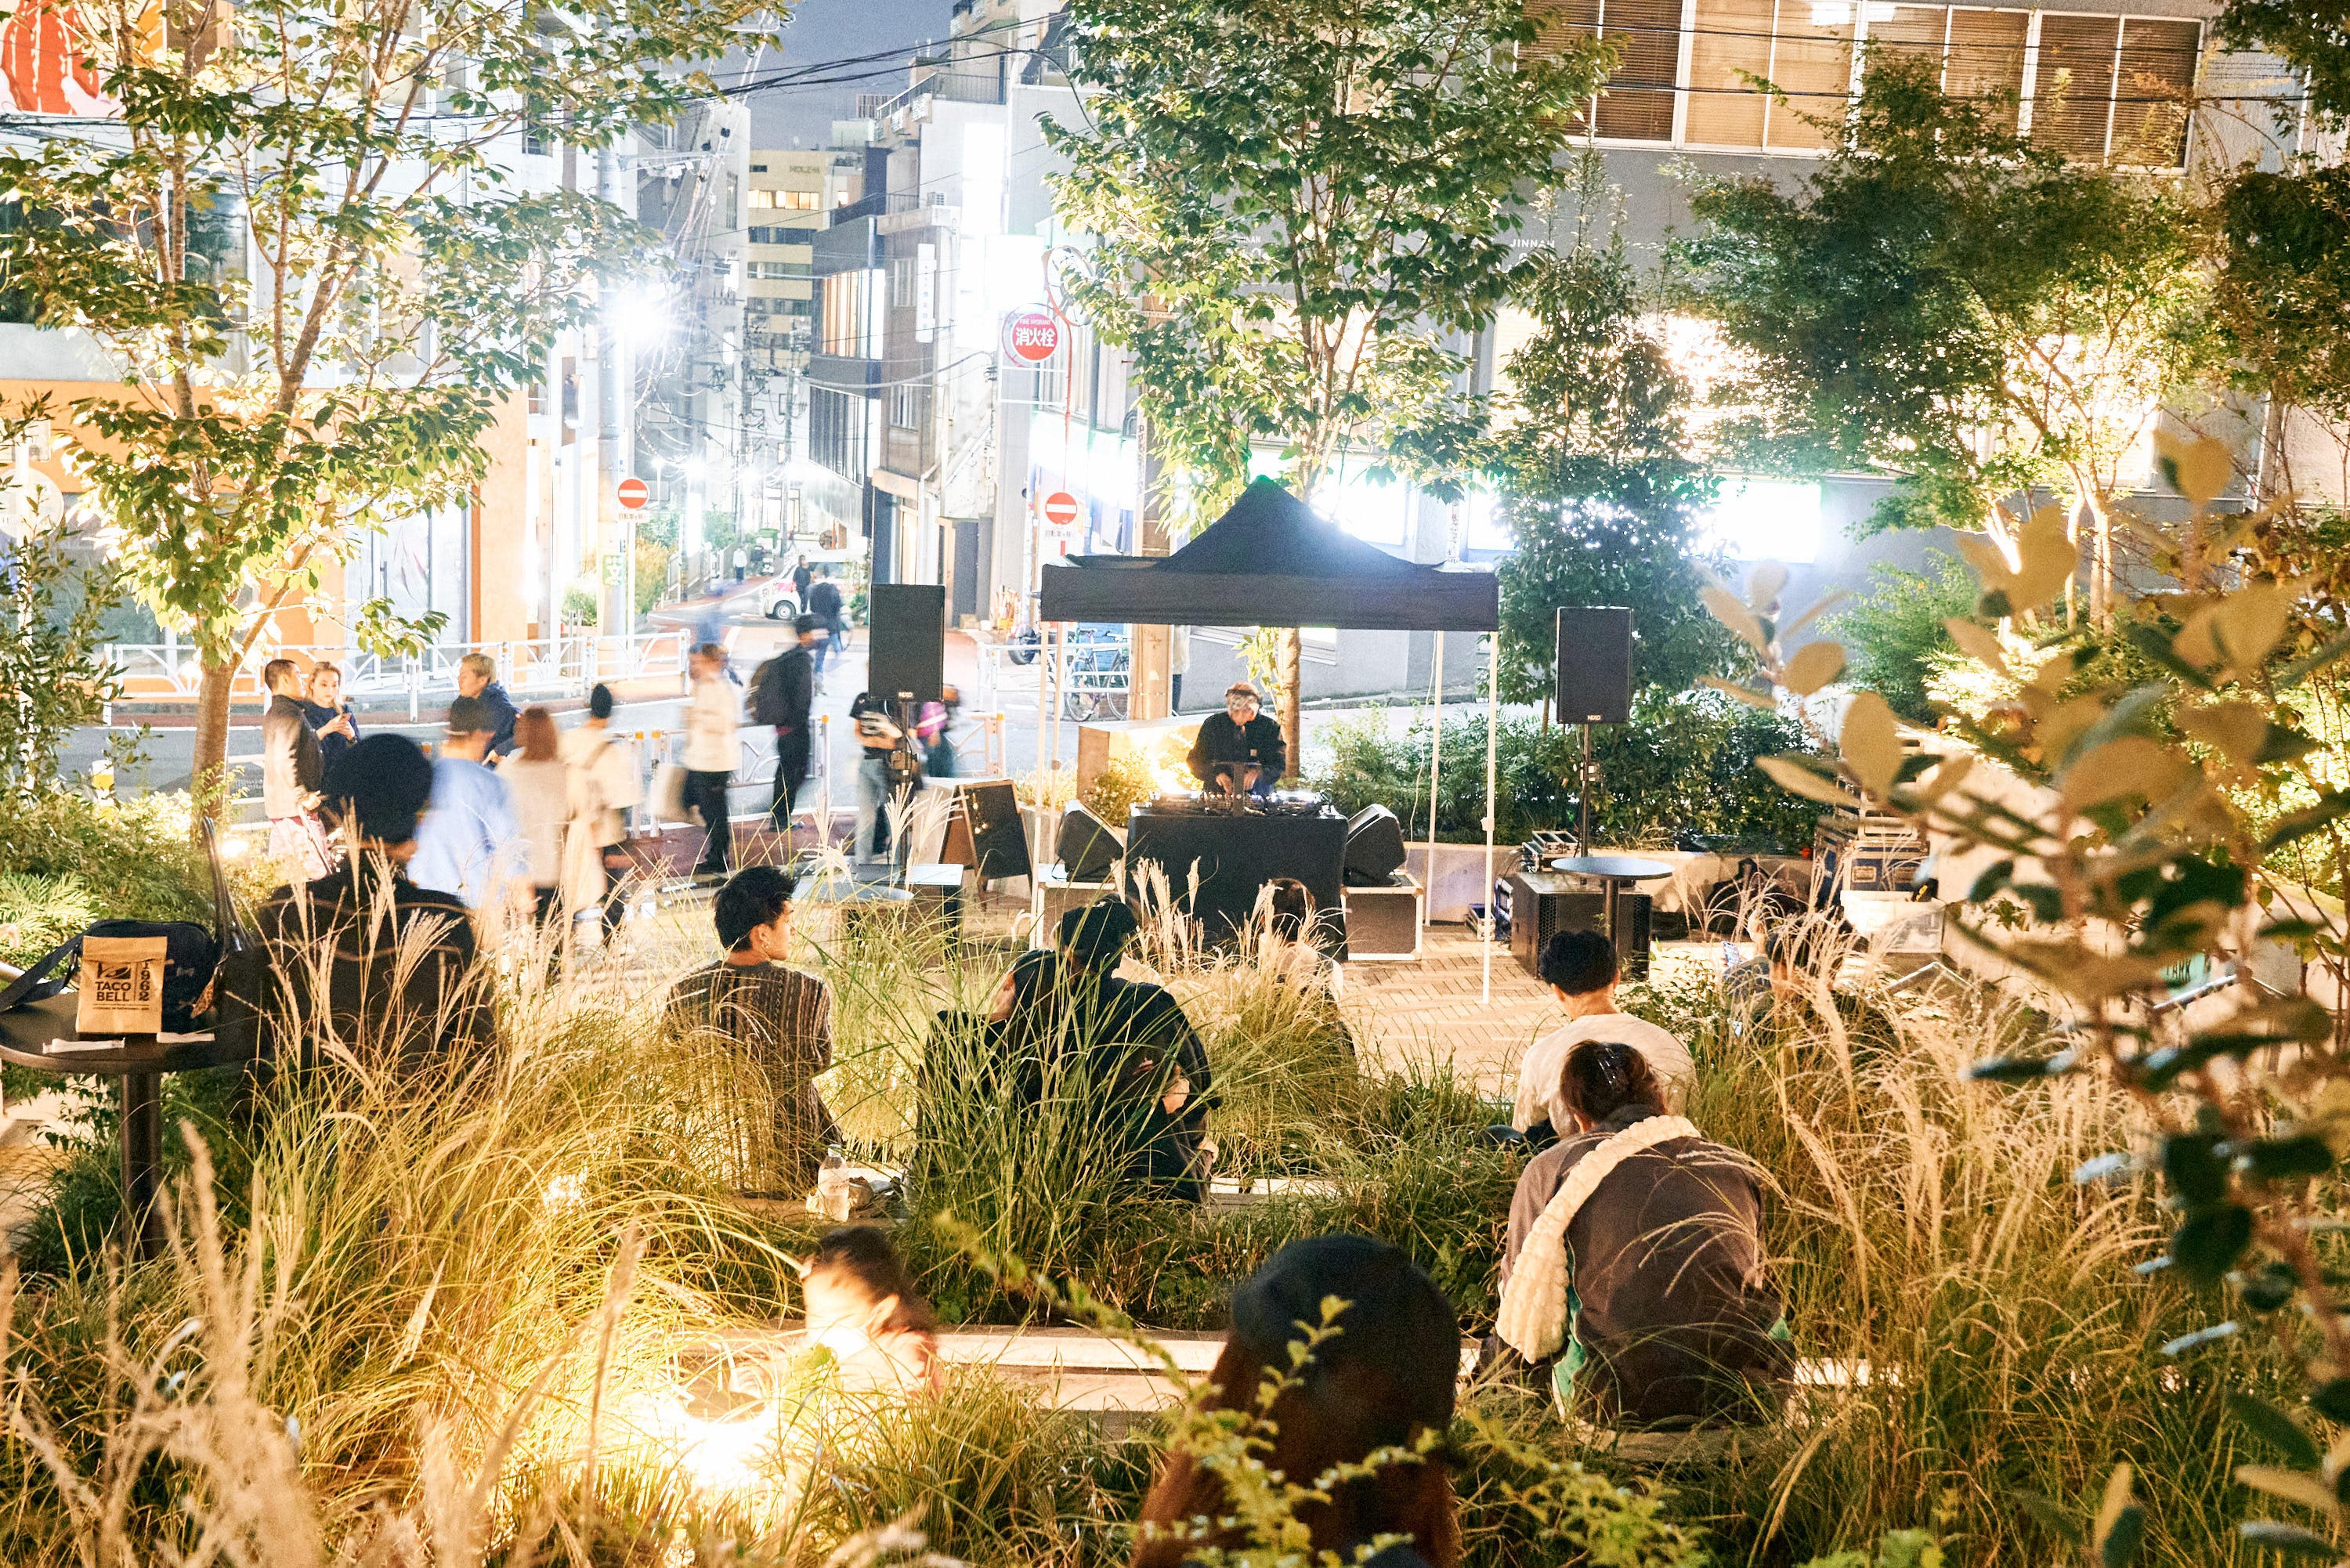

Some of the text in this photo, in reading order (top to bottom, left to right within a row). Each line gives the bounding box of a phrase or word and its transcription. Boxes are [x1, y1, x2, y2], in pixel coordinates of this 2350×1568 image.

[1510, 239, 1555, 247] JINNAN
[1015, 327, 1055, 347] 消火栓
[95, 981, 132, 991] TACO
[139, 962, 151, 1002] 1962
[96, 992, 129, 1002] BELL
